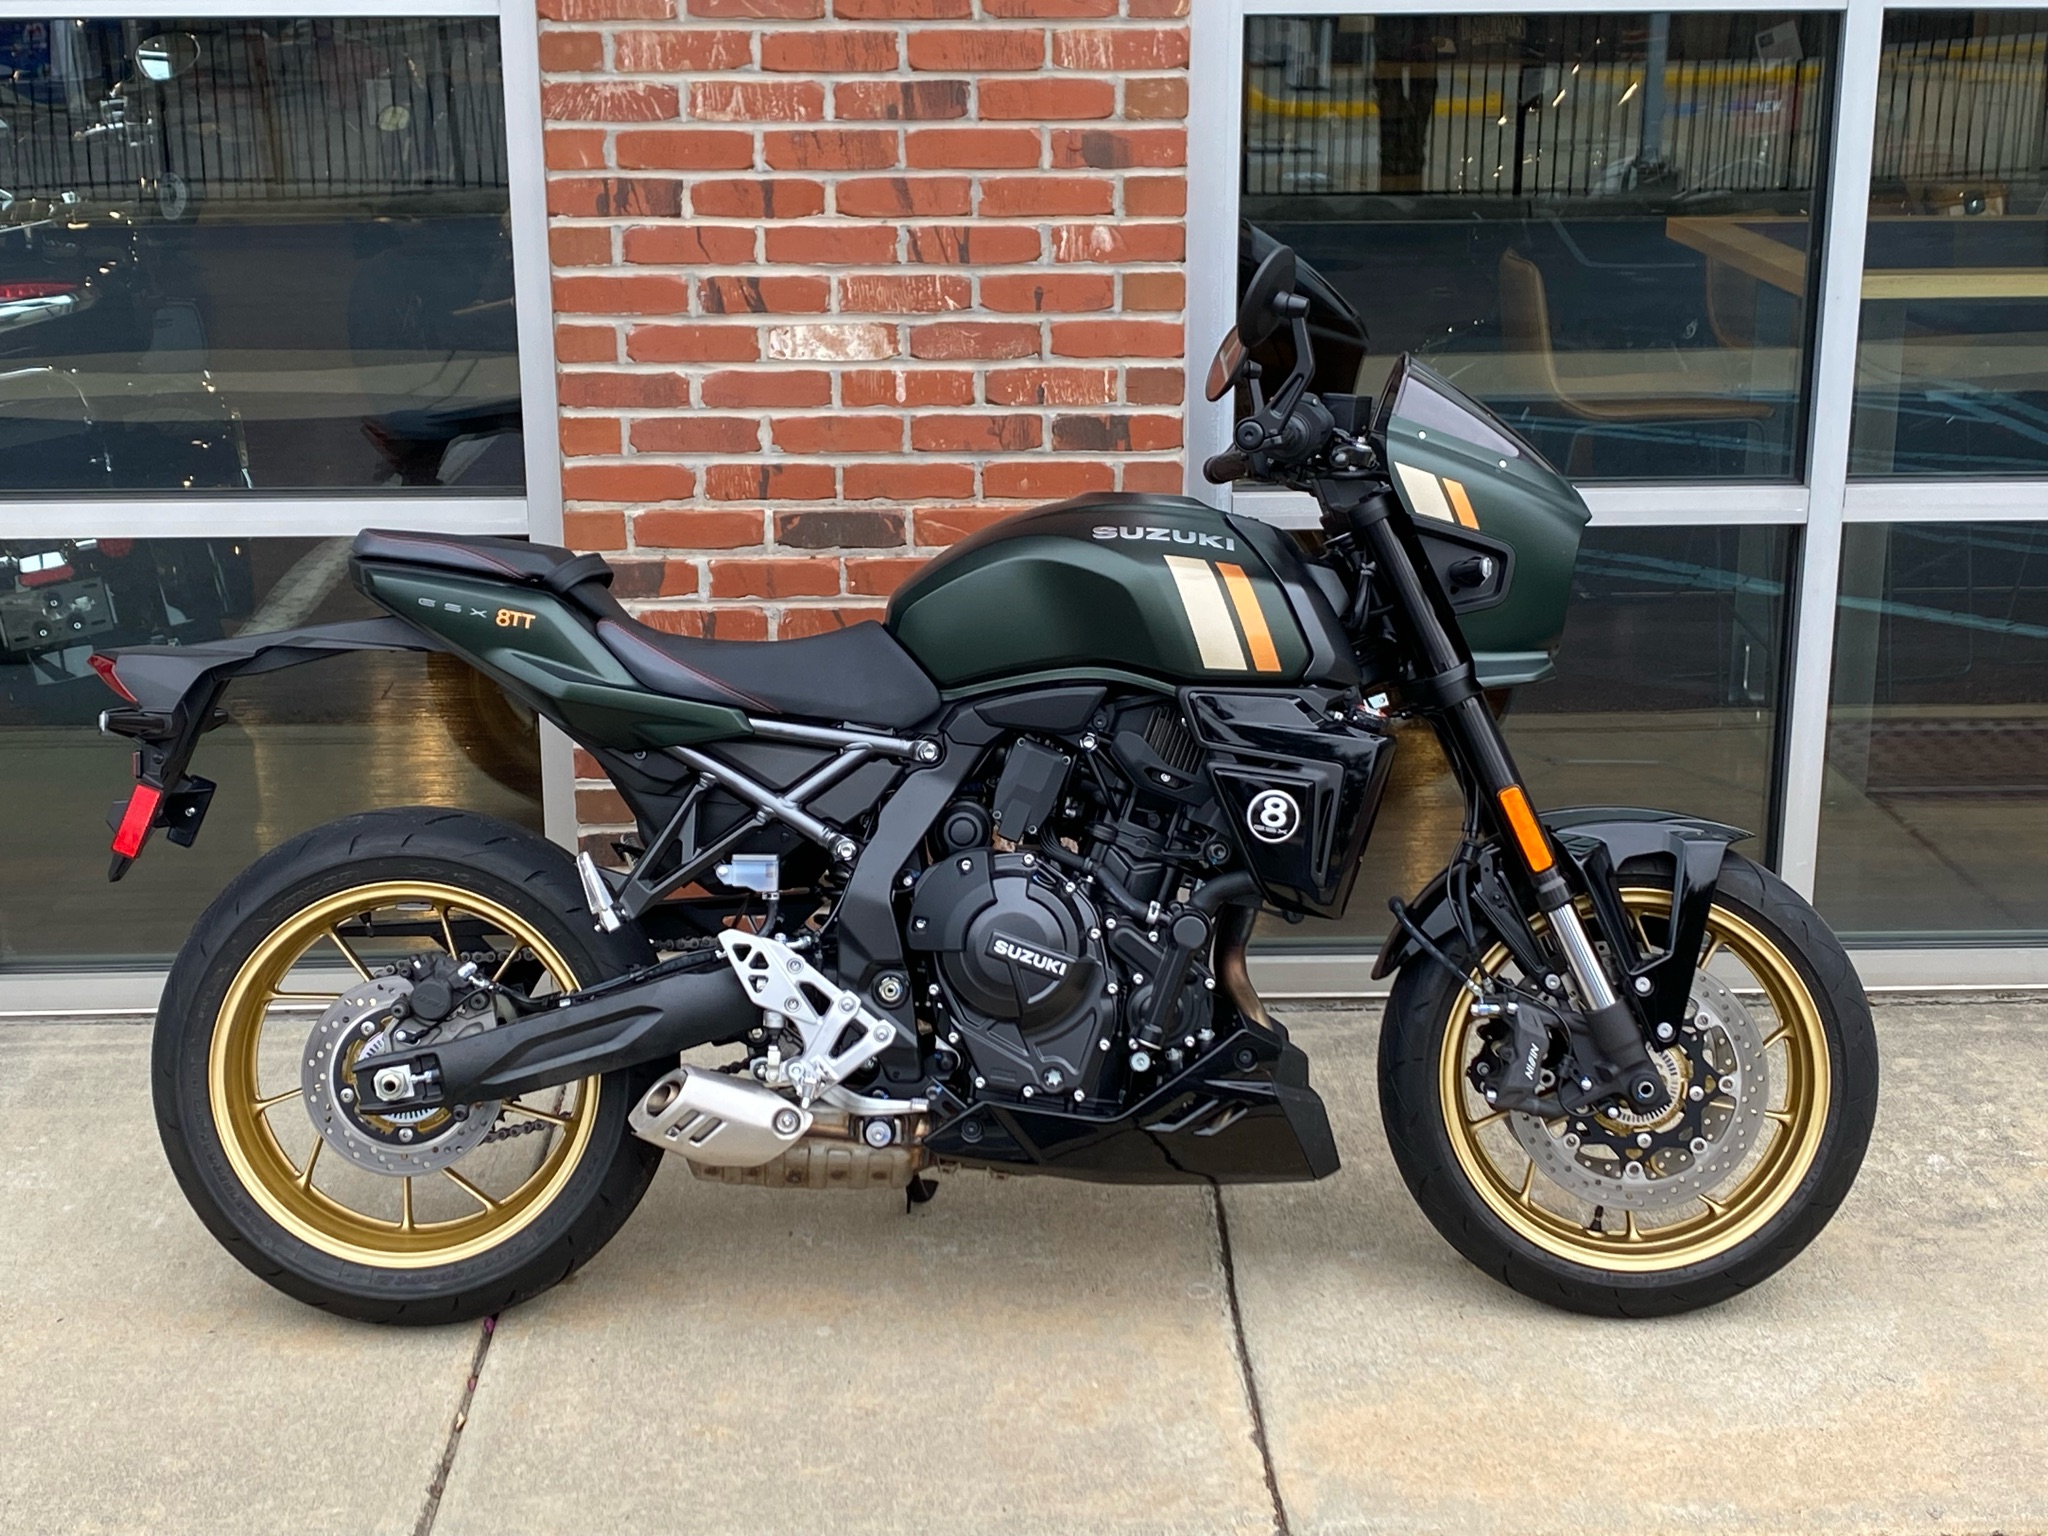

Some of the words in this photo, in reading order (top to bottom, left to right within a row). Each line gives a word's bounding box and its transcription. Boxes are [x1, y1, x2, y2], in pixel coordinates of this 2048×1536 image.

[1755, 100, 1782, 113] NEW
[1092, 525, 1235, 551] SUZUKI
[495, 608, 536, 629] 8TT
[1260, 796, 1288, 828] 8
[993, 939, 1067, 976] SUZUKI
